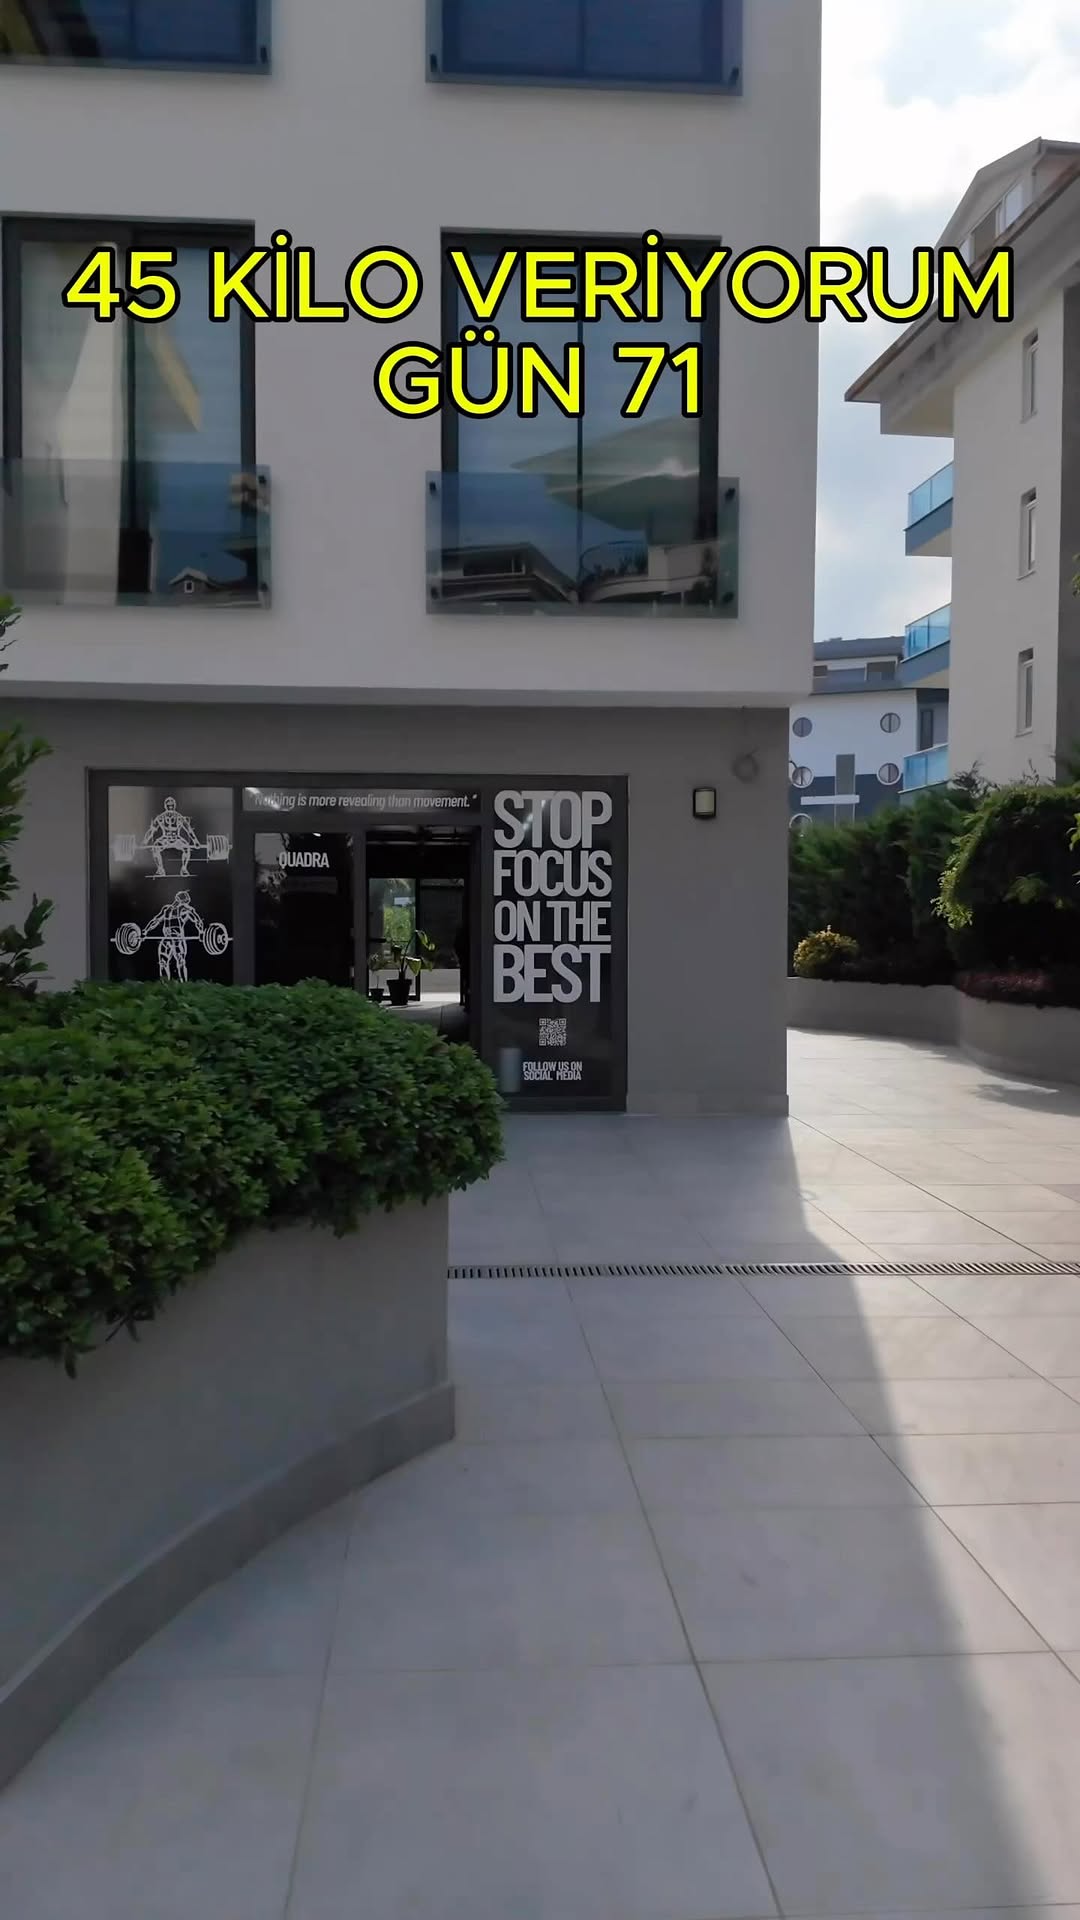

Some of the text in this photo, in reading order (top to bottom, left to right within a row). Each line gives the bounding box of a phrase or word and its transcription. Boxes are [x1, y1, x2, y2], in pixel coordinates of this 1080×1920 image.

[297, 793, 307, 807] is
[308, 795, 337, 808] more
[338, 793, 385, 811] revealing
[387, 793, 412, 808] than
[493, 790, 613, 849] STOP
[278, 851, 330, 870] QUADRA
[493, 849, 613, 897] FOCUS
[494, 899, 612, 942] ON THE
[493, 943, 612, 1003] BEST
[522, 1061, 583, 1072] FOLLOW US ON
[523, 1070, 582, 1081] SOCIAL MEDIA
